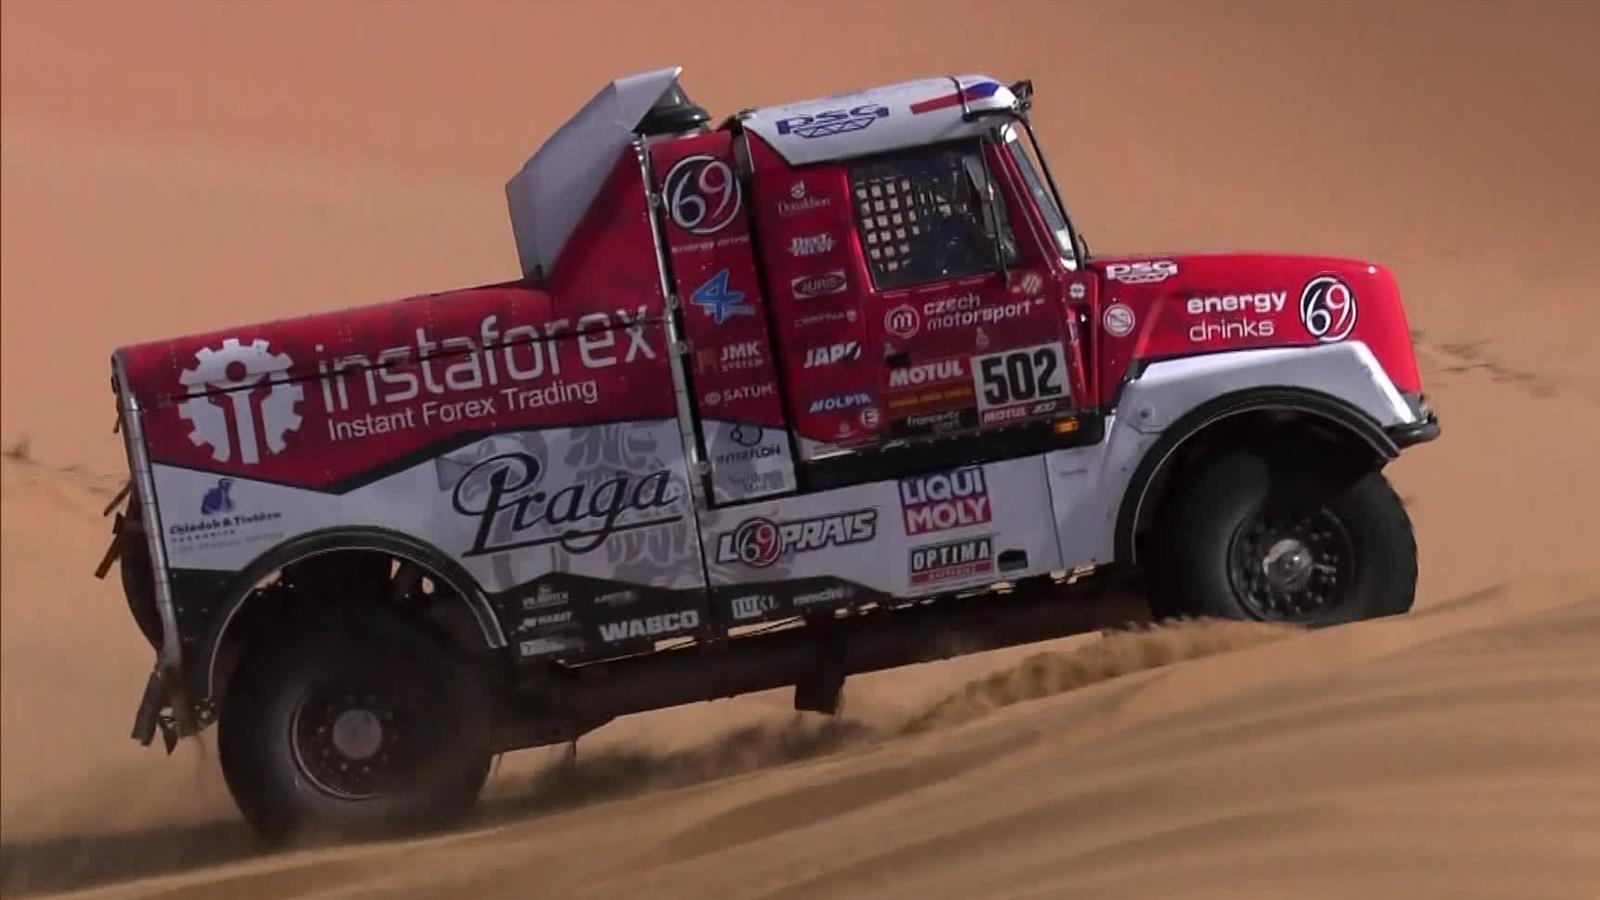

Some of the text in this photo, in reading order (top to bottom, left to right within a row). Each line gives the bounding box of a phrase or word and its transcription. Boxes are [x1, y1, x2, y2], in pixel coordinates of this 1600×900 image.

[666, 157, 738, 232] 69
[923, 293, 981, 315] czech
[926, 300, 1032, 331] motorsport
[1187, 291, 1287, 315] energy
[1303, 280, 1354, 340] 69
[1190, 319, 1275, 342] drinks
[315, 304, 656, 413] instaforex
[721, 341, 761, 361] JMK
[889, 360, 964, 388] MOTUL
[979, 348, 1063, 405] 502
[327, 379, 599, 442] Instant Forex Trading
[983, 406, 1028, 424] MOTUL
[902, 467, 985, 505] LIQUI
[453, 452, 681, 556] Praga
[906, 498, 988, 534] MOLY
[912, 541, 990, 571] OPTIMA
[599, 609, 700, 642] WABCO
